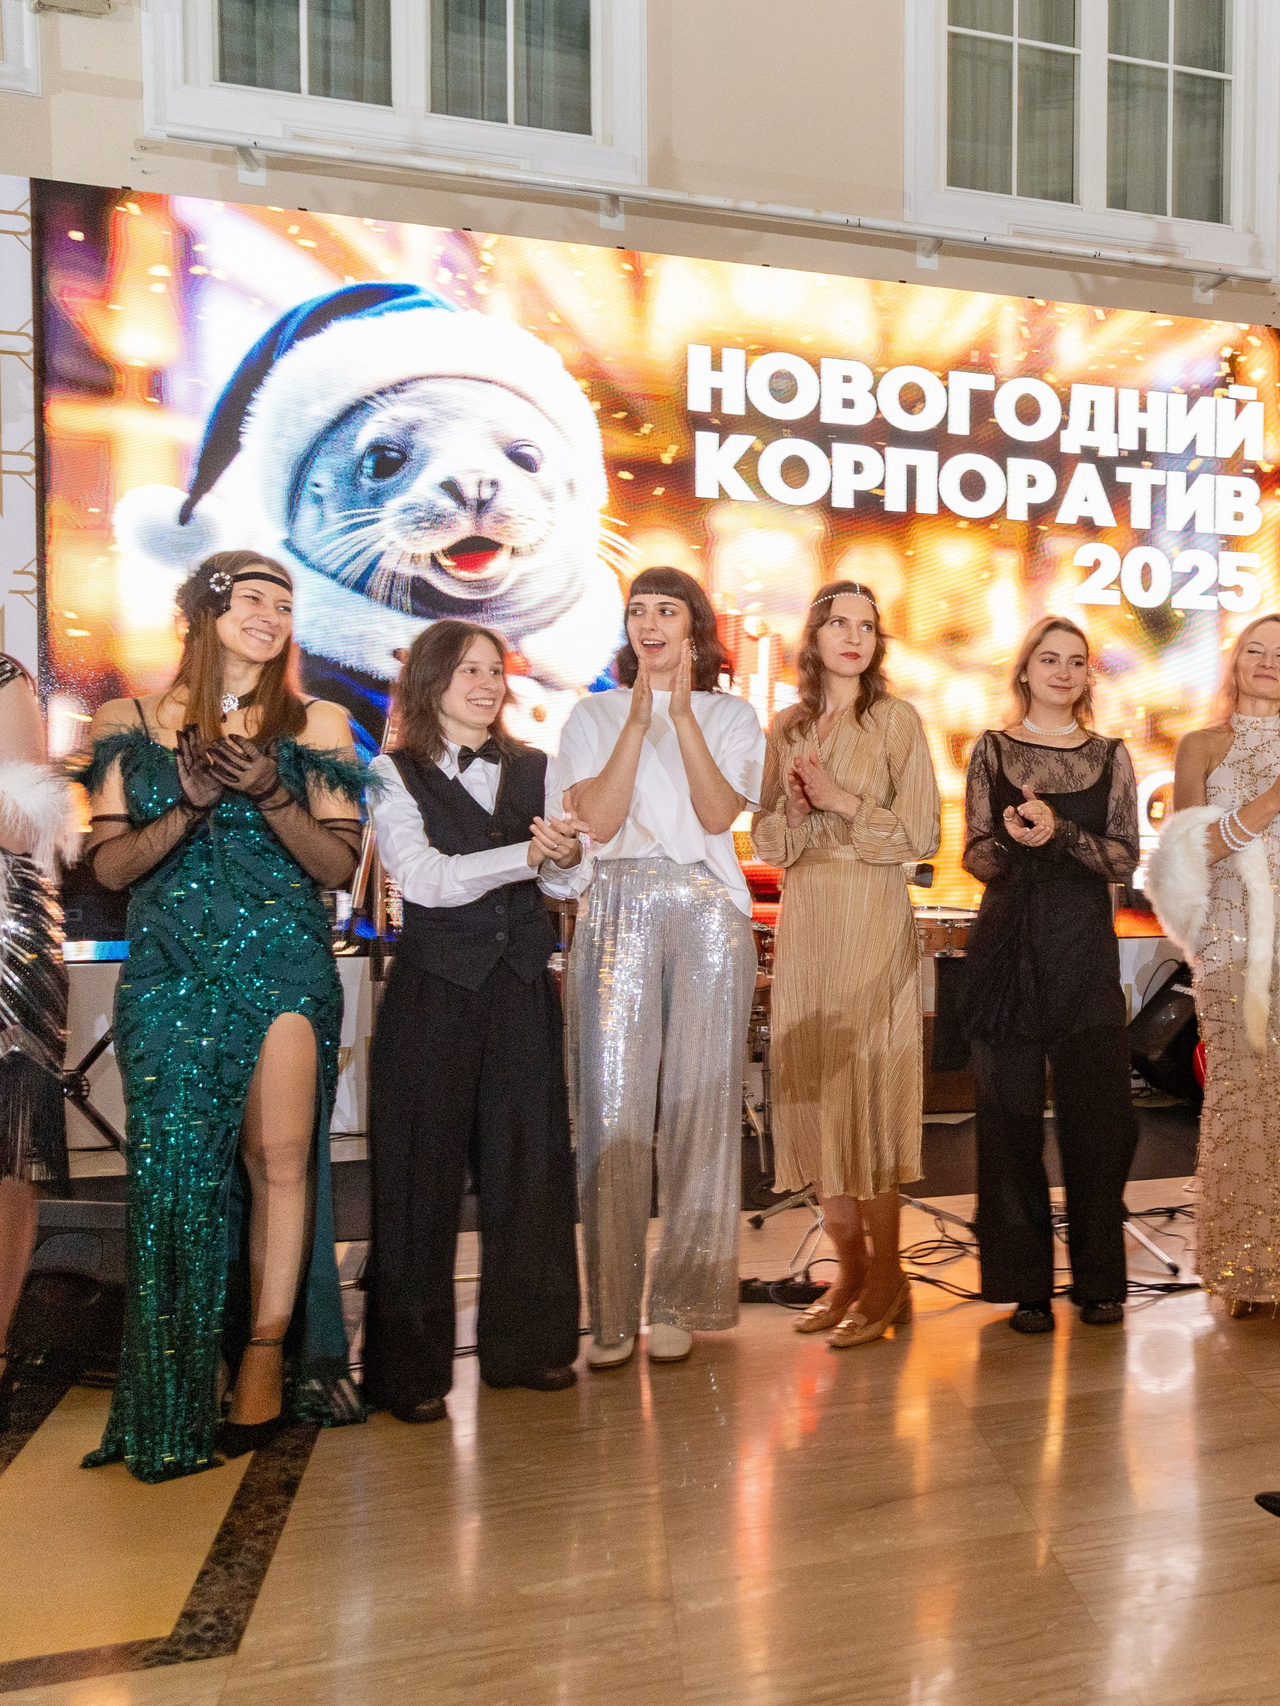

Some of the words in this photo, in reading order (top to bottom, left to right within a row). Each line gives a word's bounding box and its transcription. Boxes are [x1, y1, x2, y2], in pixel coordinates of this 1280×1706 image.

[687, 344, 1265, 461] НОВОГОДНИЙ
[694, 431, 1262, 537] КОРПОРАТИВ
[1072, 544, 1262, 612] 2025
